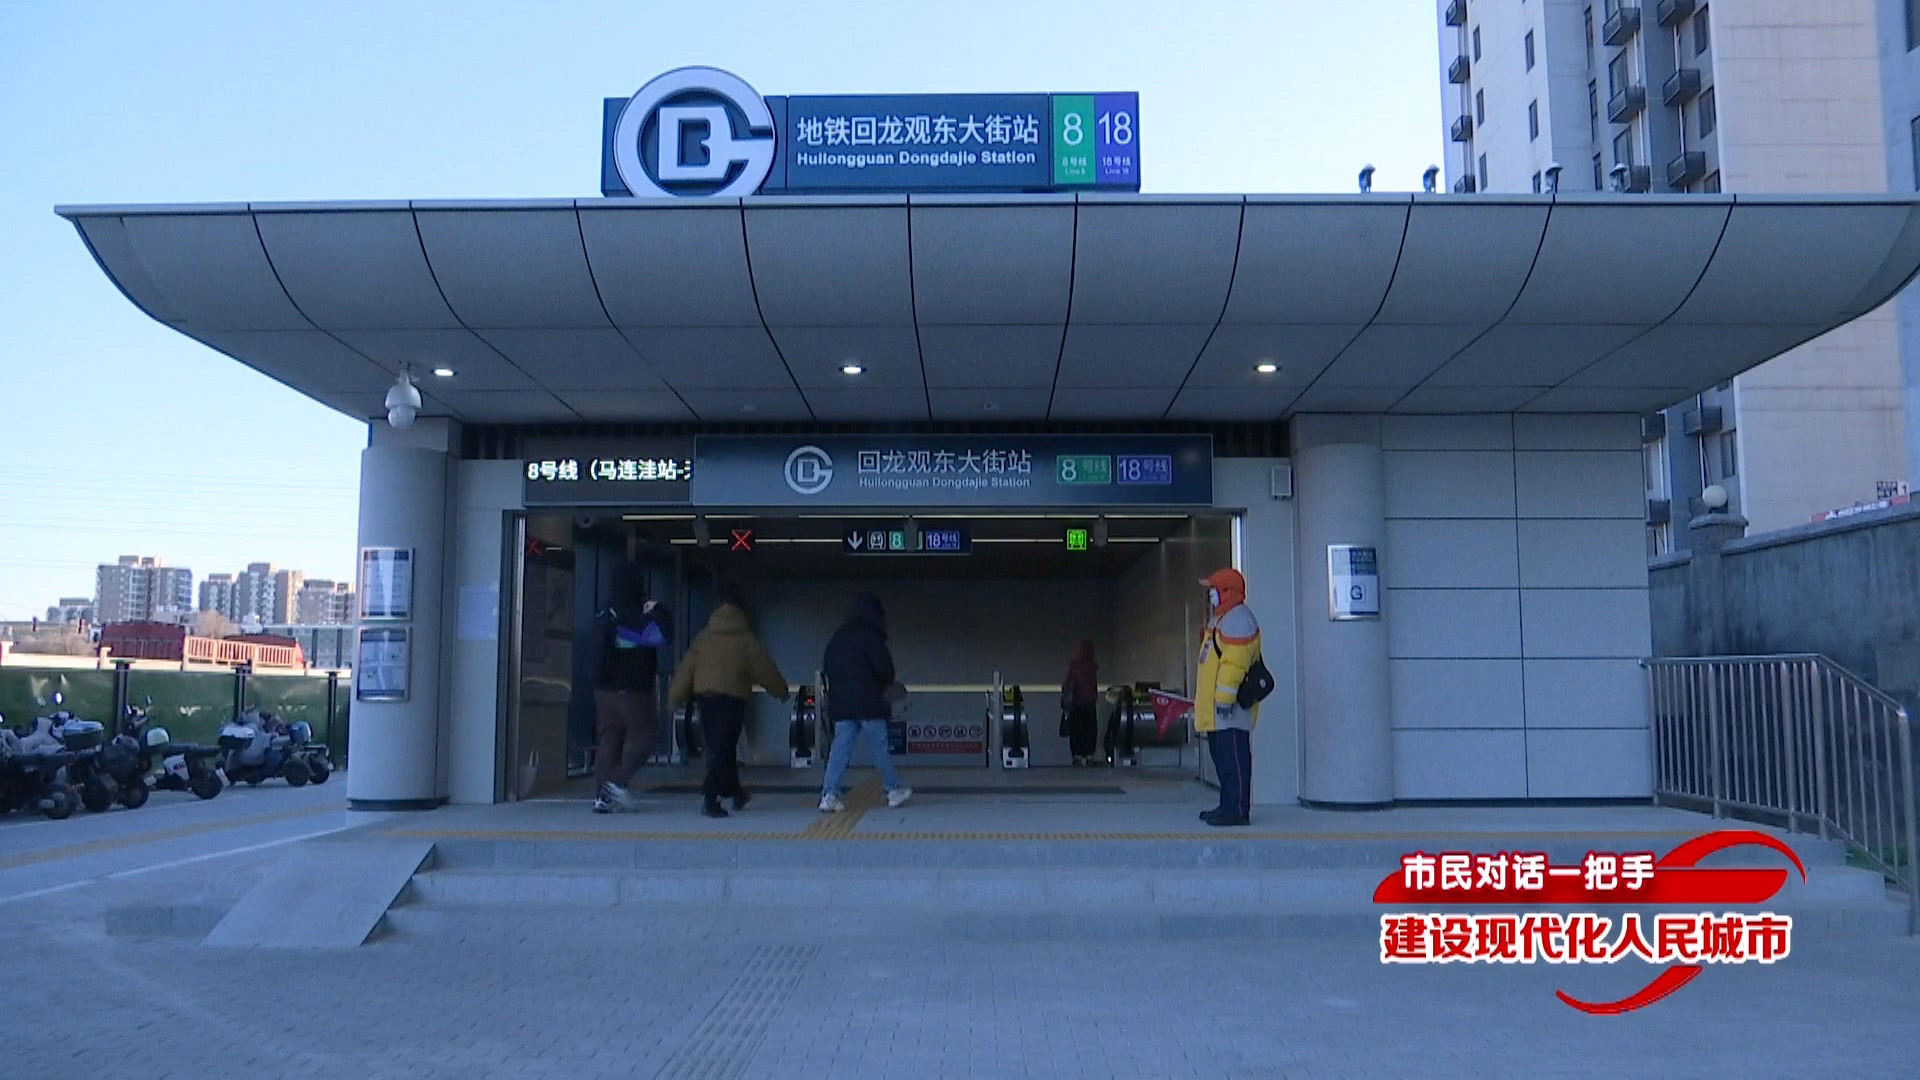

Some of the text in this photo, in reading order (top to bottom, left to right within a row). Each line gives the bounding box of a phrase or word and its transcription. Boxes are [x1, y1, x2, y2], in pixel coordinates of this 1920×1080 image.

[796, 115, 1040, 146] 地铁回龙观东大街站
[1063, 112, 1083, 146] 8
[1099, 111, 1132, 145] 18
[797, 151, 1036, 168] Huilongguan Dongdajie Station
[857, 449, 1032, 474] 回龙观东大街站
[859, 477, 1031, 489] Huilongguan Dongdajie Station
[1351, 585, 1363, 601] G
